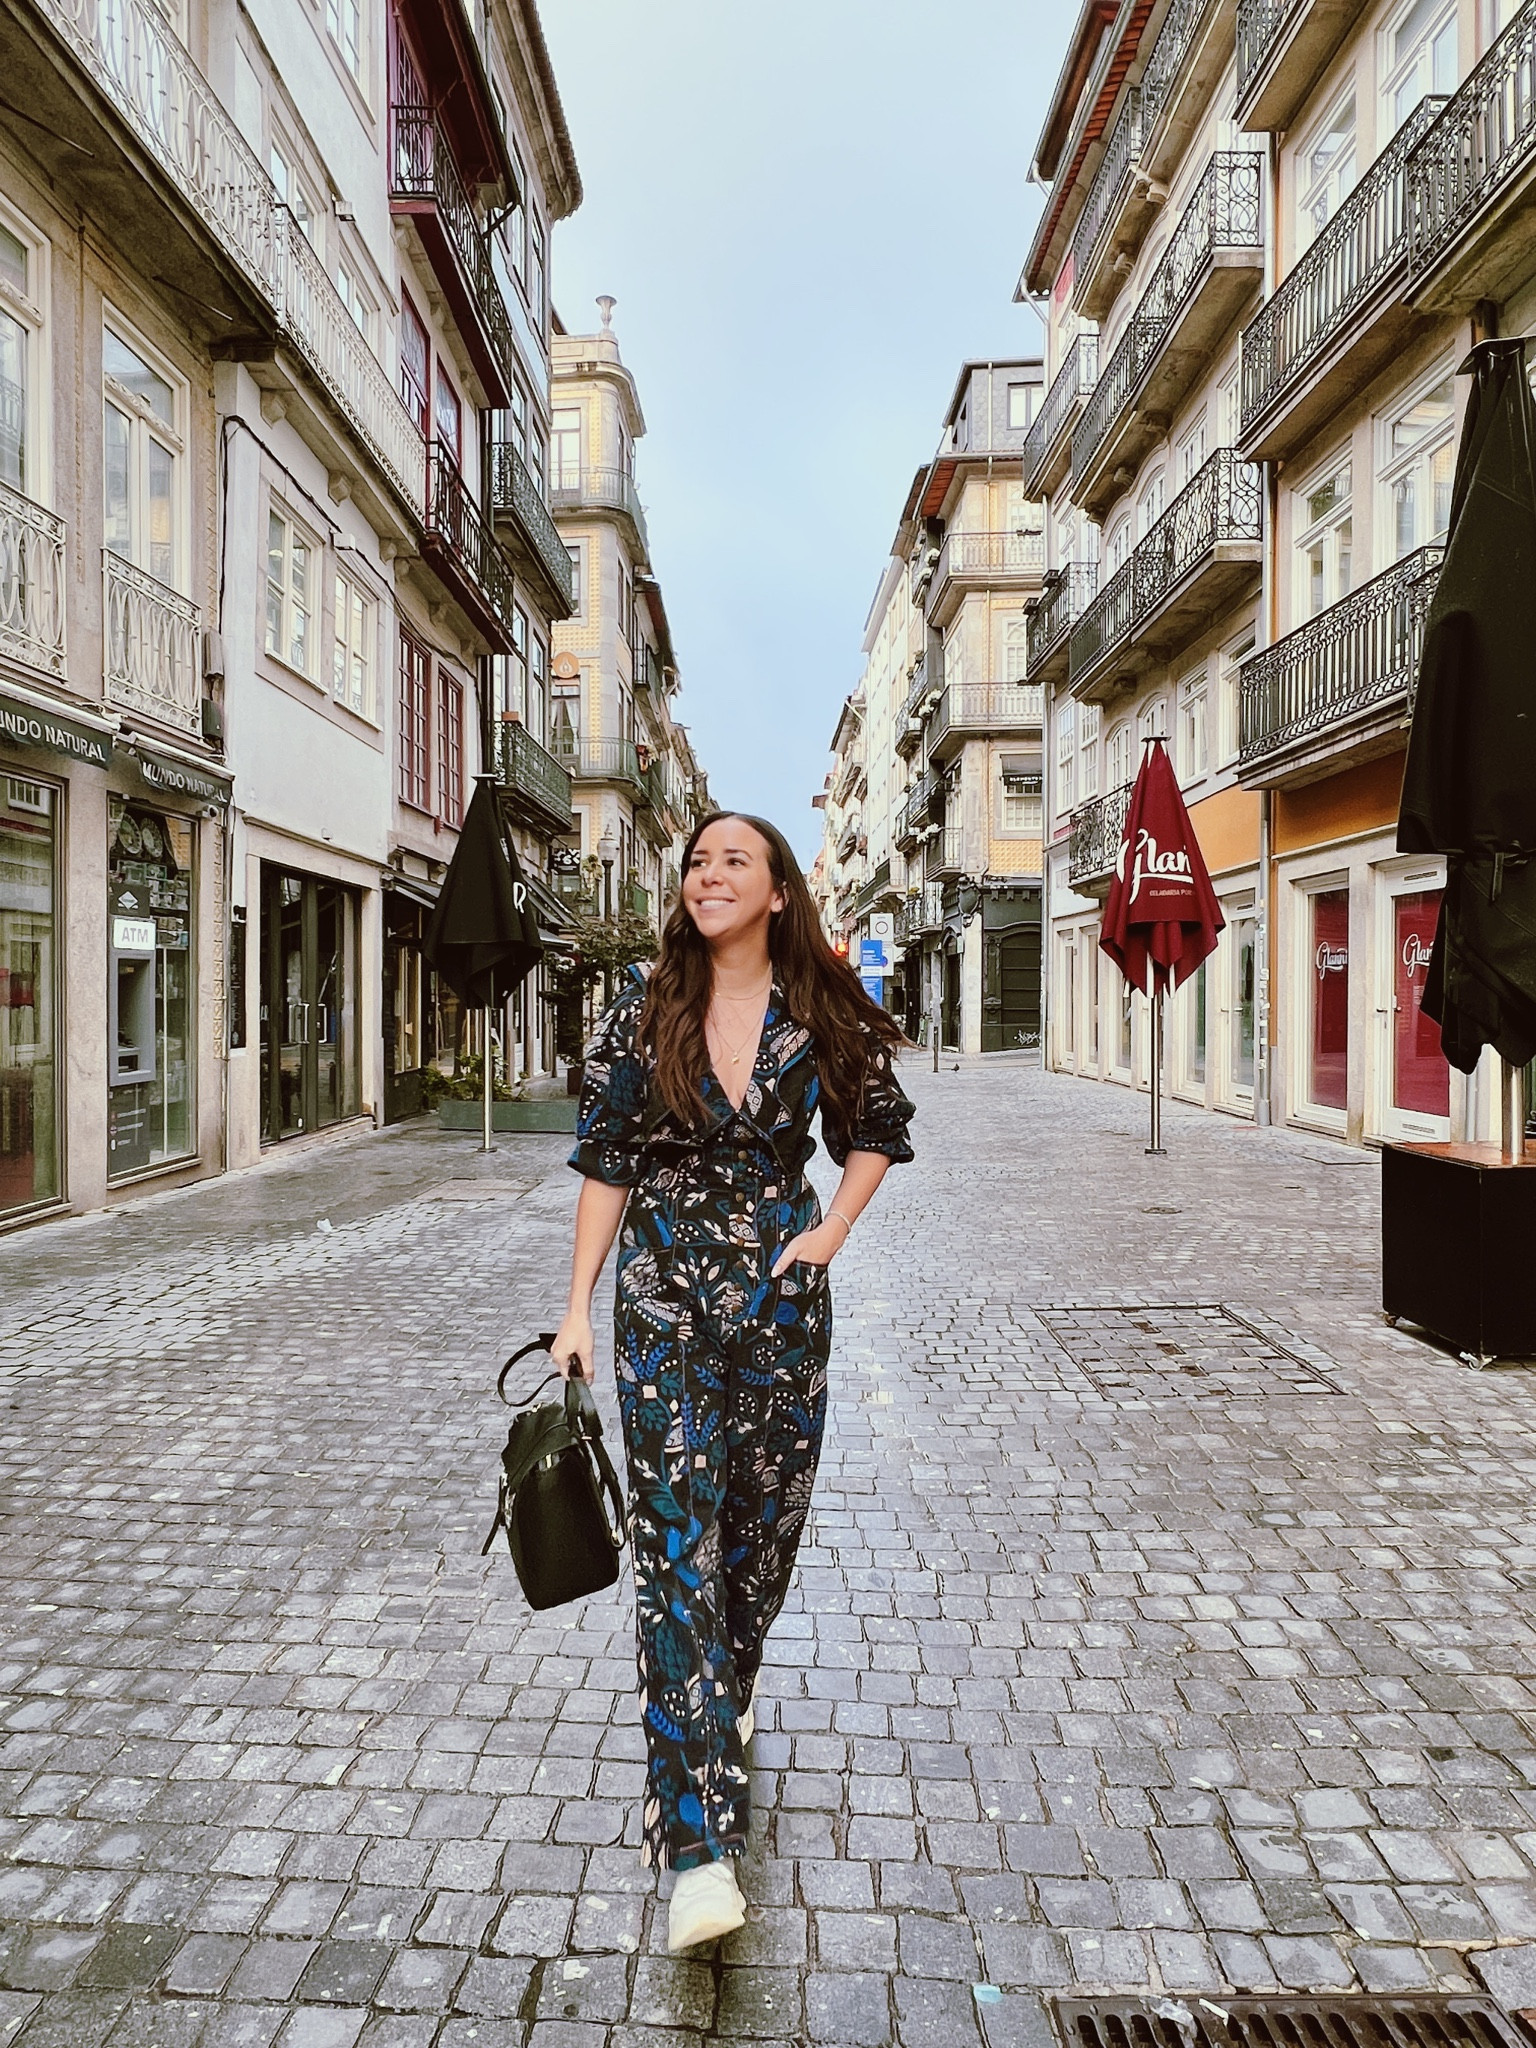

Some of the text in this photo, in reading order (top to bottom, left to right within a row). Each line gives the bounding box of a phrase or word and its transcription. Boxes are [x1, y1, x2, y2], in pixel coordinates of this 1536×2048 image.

[44, 724, 106, 762] NATURAL
[142, 761, 185, 789] MUNDO
[121, 926, 149, 943] ATM
